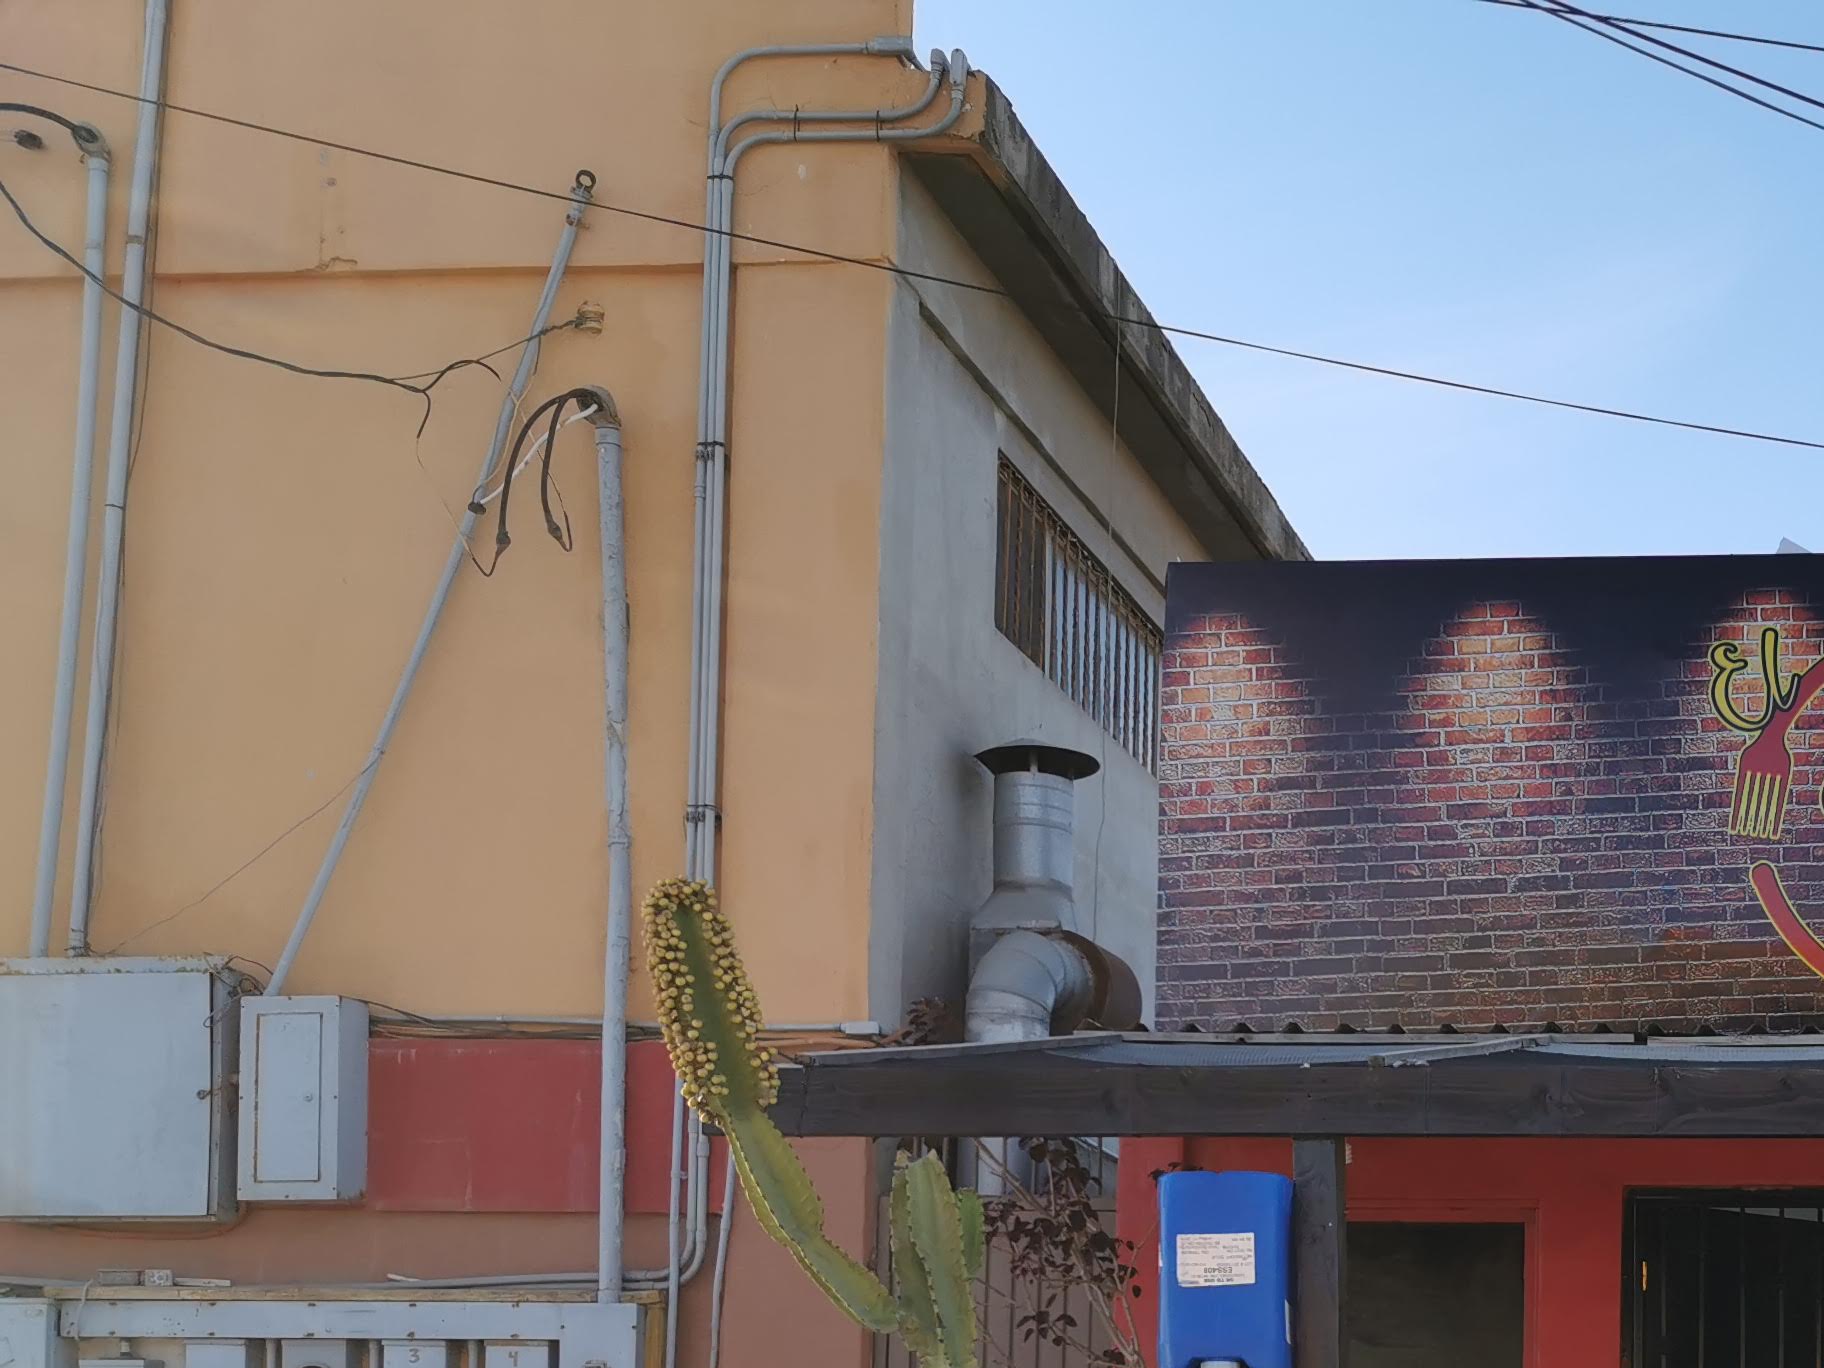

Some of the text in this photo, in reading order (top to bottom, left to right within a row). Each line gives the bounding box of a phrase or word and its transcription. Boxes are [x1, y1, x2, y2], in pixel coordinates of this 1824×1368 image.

[1710, 626, 1801, 729] El
[408, 1348, 420, 1364] 3
[507, 1350, 519, 1367] 4
